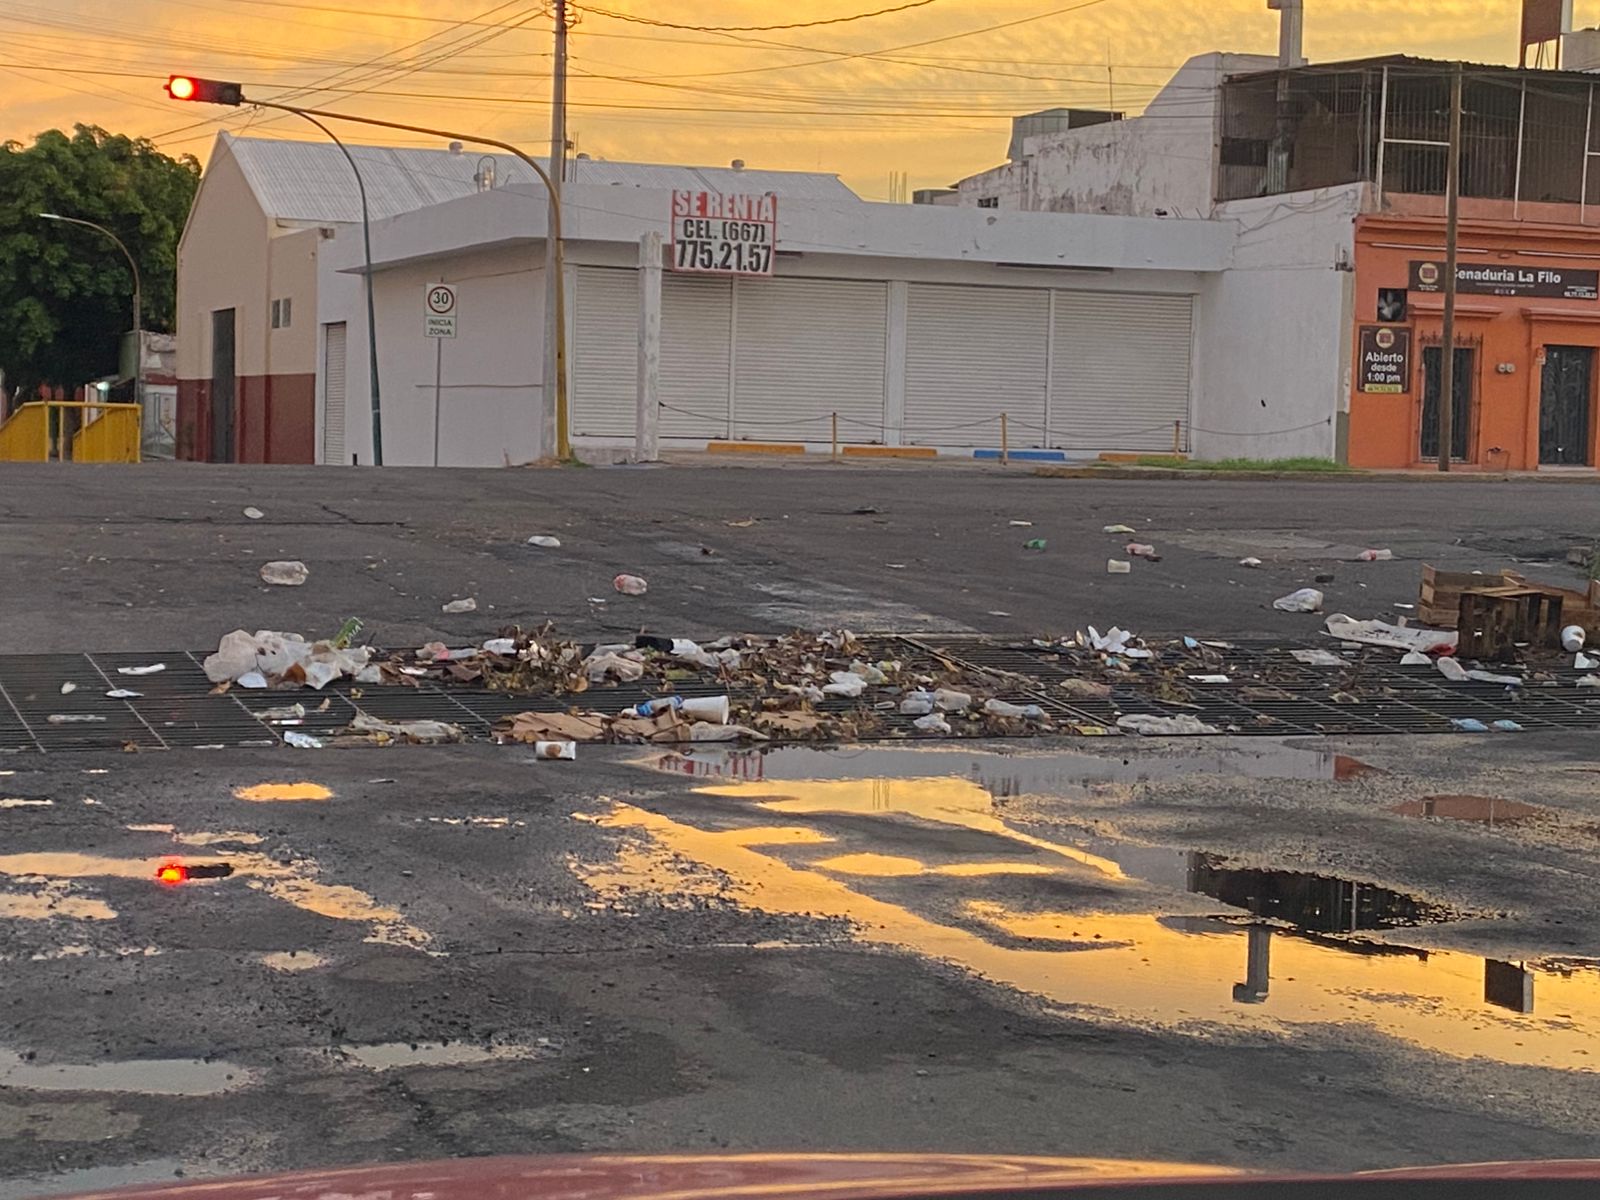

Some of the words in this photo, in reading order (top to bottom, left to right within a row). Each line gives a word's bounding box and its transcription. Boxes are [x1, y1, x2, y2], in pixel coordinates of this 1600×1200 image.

[674, 190, 702, 217] SE
[706, 192, 775, 221] RENTA
[683, 219, 717, 240] CEL.
[721, 221, 765, 243] (667)
[676, 240, 771, 272] 775.21.57
[1518, 269, 1535, 283] La
[1537, 271, 1561, 284] Filo
[432, 291, 449, 305] 30
[428, 319, 452, 327] INICIA
[429, 327, 452, 336] ZONA
[1365, 351, 1404, 363] Abierto
[1370, 363, 1397, 372] desde
[1367, 372, 1385, 382] 1:00
[1386, 374, 1401, 384] pm
